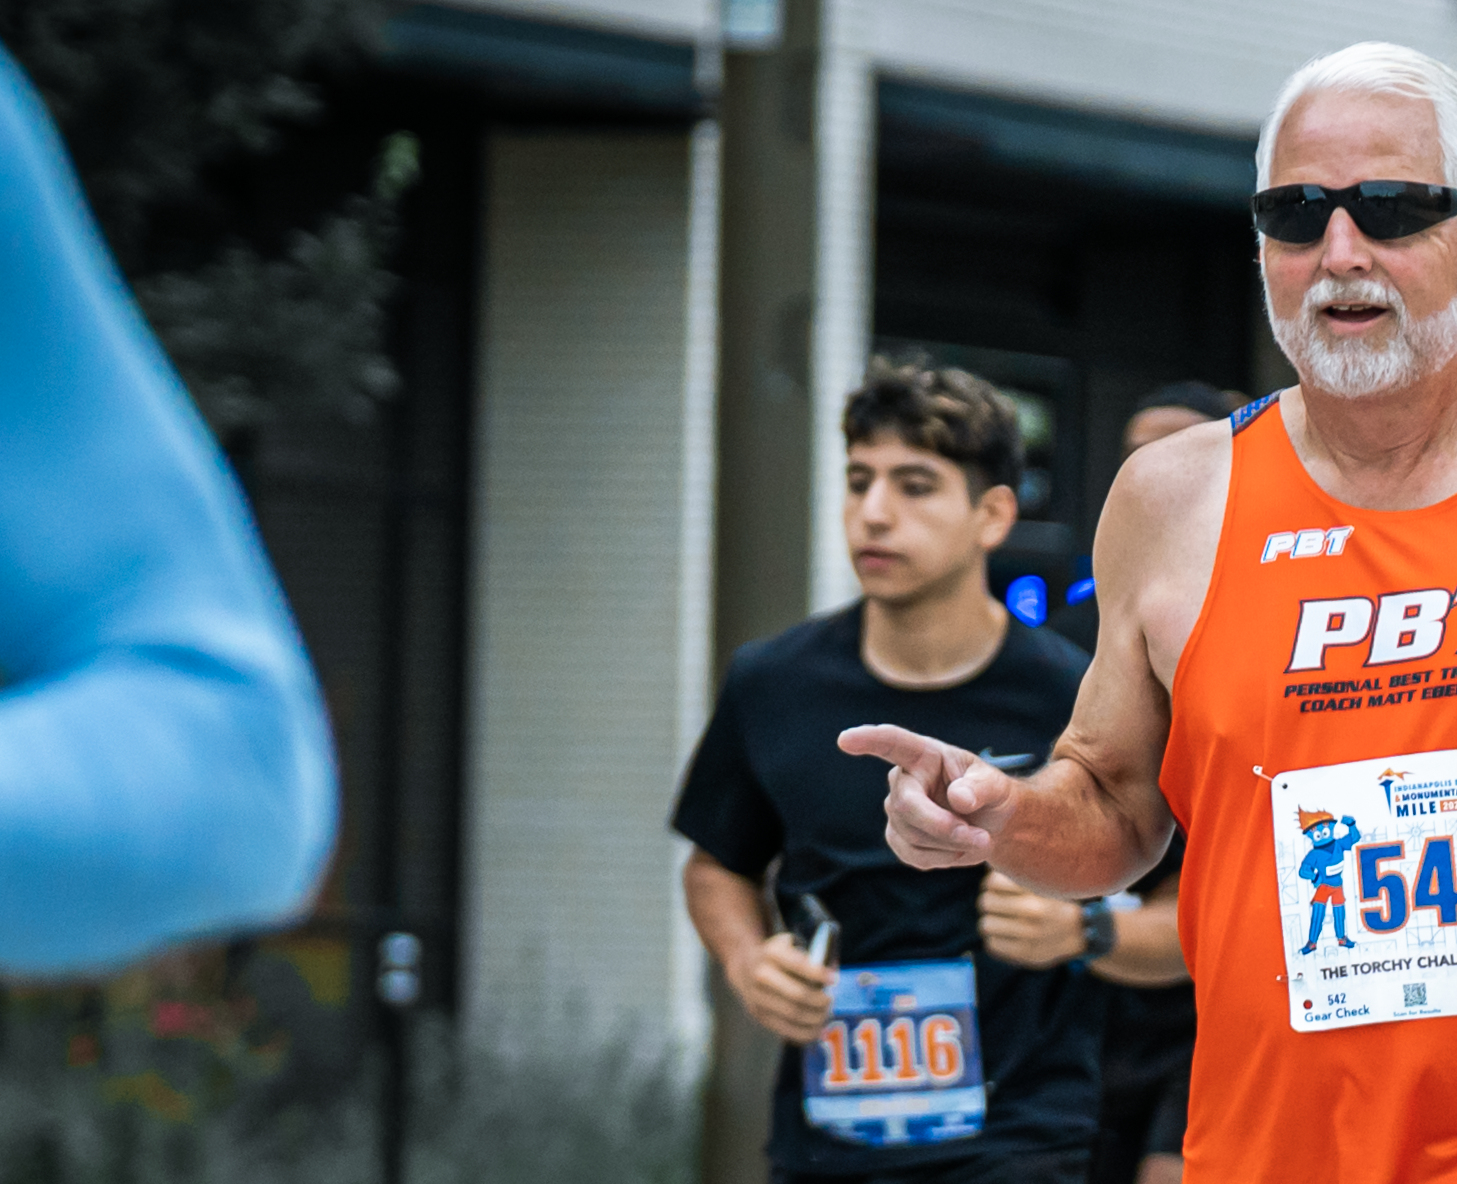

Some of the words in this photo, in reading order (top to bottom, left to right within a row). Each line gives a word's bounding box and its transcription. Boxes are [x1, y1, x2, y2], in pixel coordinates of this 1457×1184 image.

[1260, 525, 1355, 564] PBT
[1284, 678, 1382, 698] PERSONAL
[1389, 670, 1434, 688] BEST
[1300, 697, 1362, 713] COACH
[1367, 689, 1417, 707] MATT
[1394, 780, 1452, 792] INDIANAPOLIS
[1396, 801, 1436, 817] MILE
[1320, 965, 1348, 981] THE
[1351, 957, 1413, 976] TORCHY
[1327, 992, 1347, 1006] 542
[1304, 1012, 1332, 1023] Gear
[1335, 1004, 1370, 1019] Check
[821, 1013, 964, 1091] 1116
